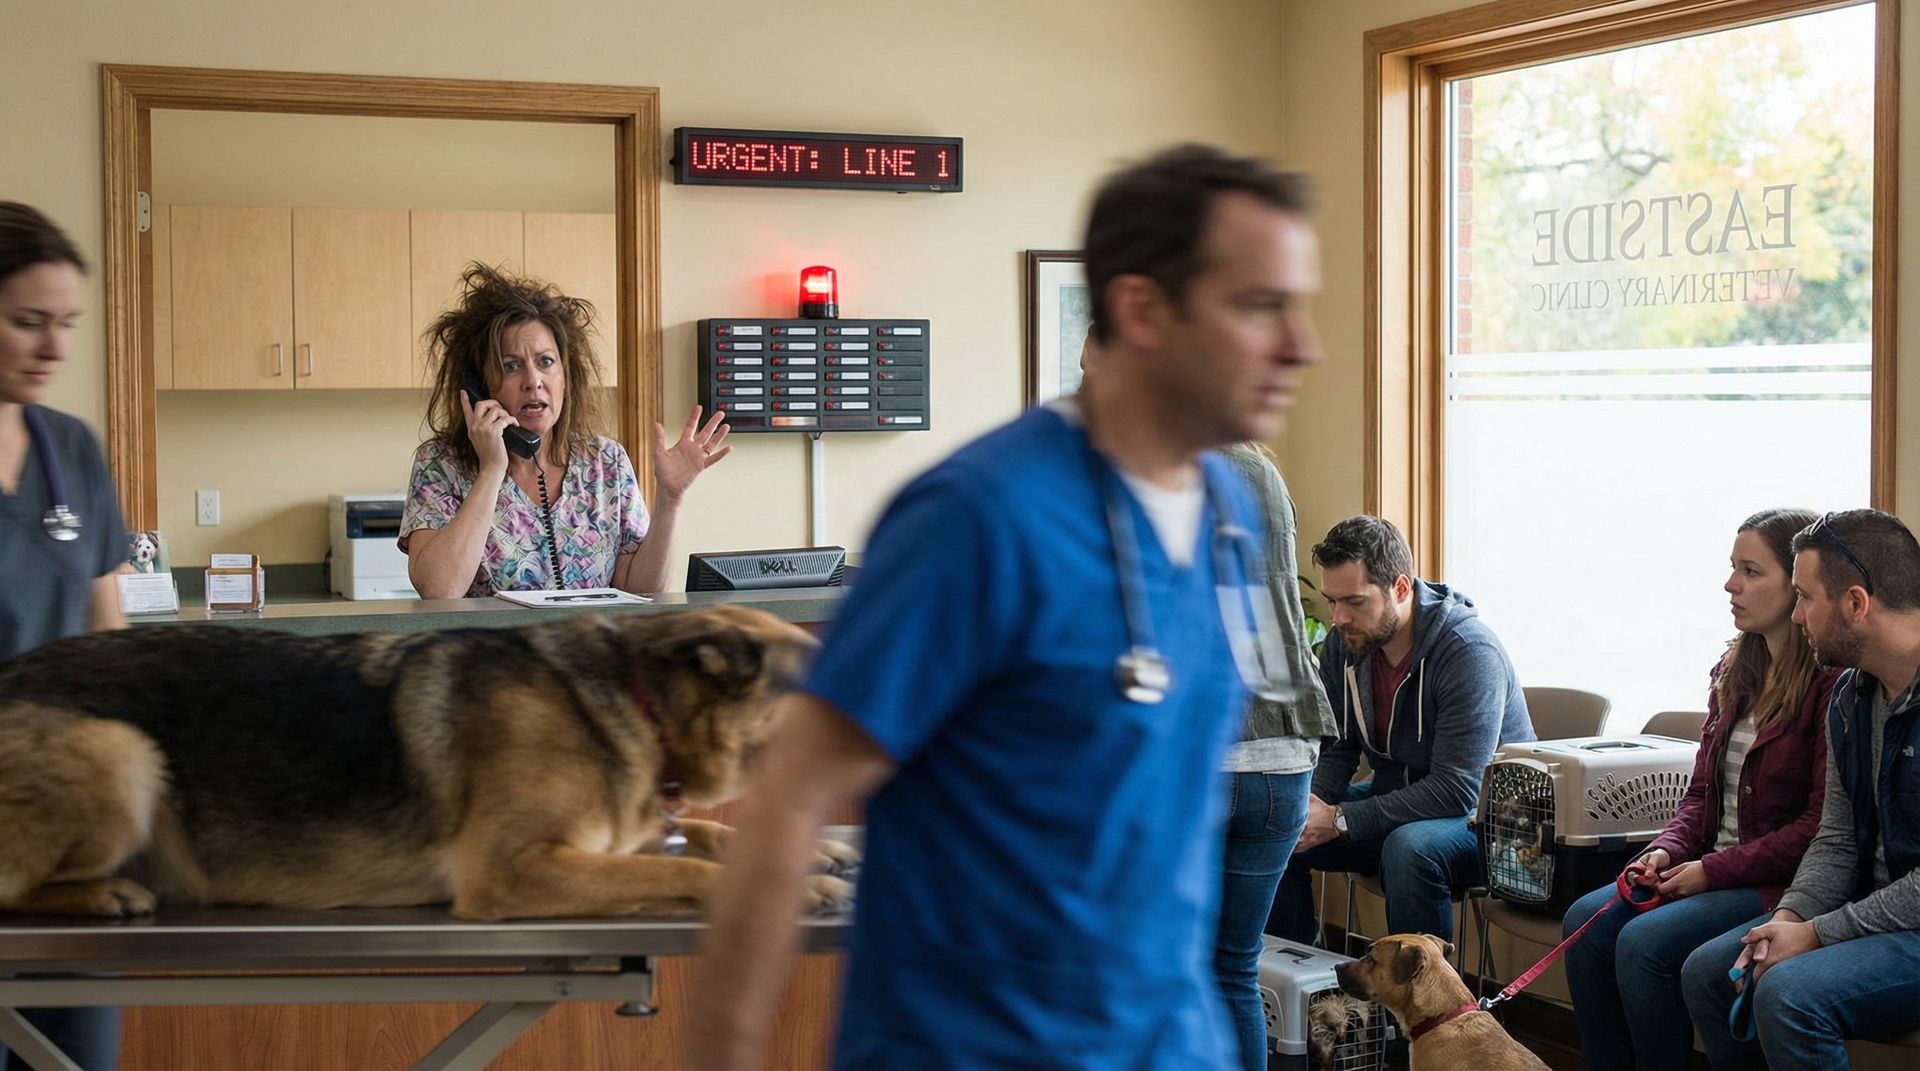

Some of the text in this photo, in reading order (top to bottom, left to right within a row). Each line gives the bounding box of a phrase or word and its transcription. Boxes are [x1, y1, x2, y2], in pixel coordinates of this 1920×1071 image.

[693, 141, 949, 177] URGENT: LINE 1
[760, 559, 798, 575] DELL
